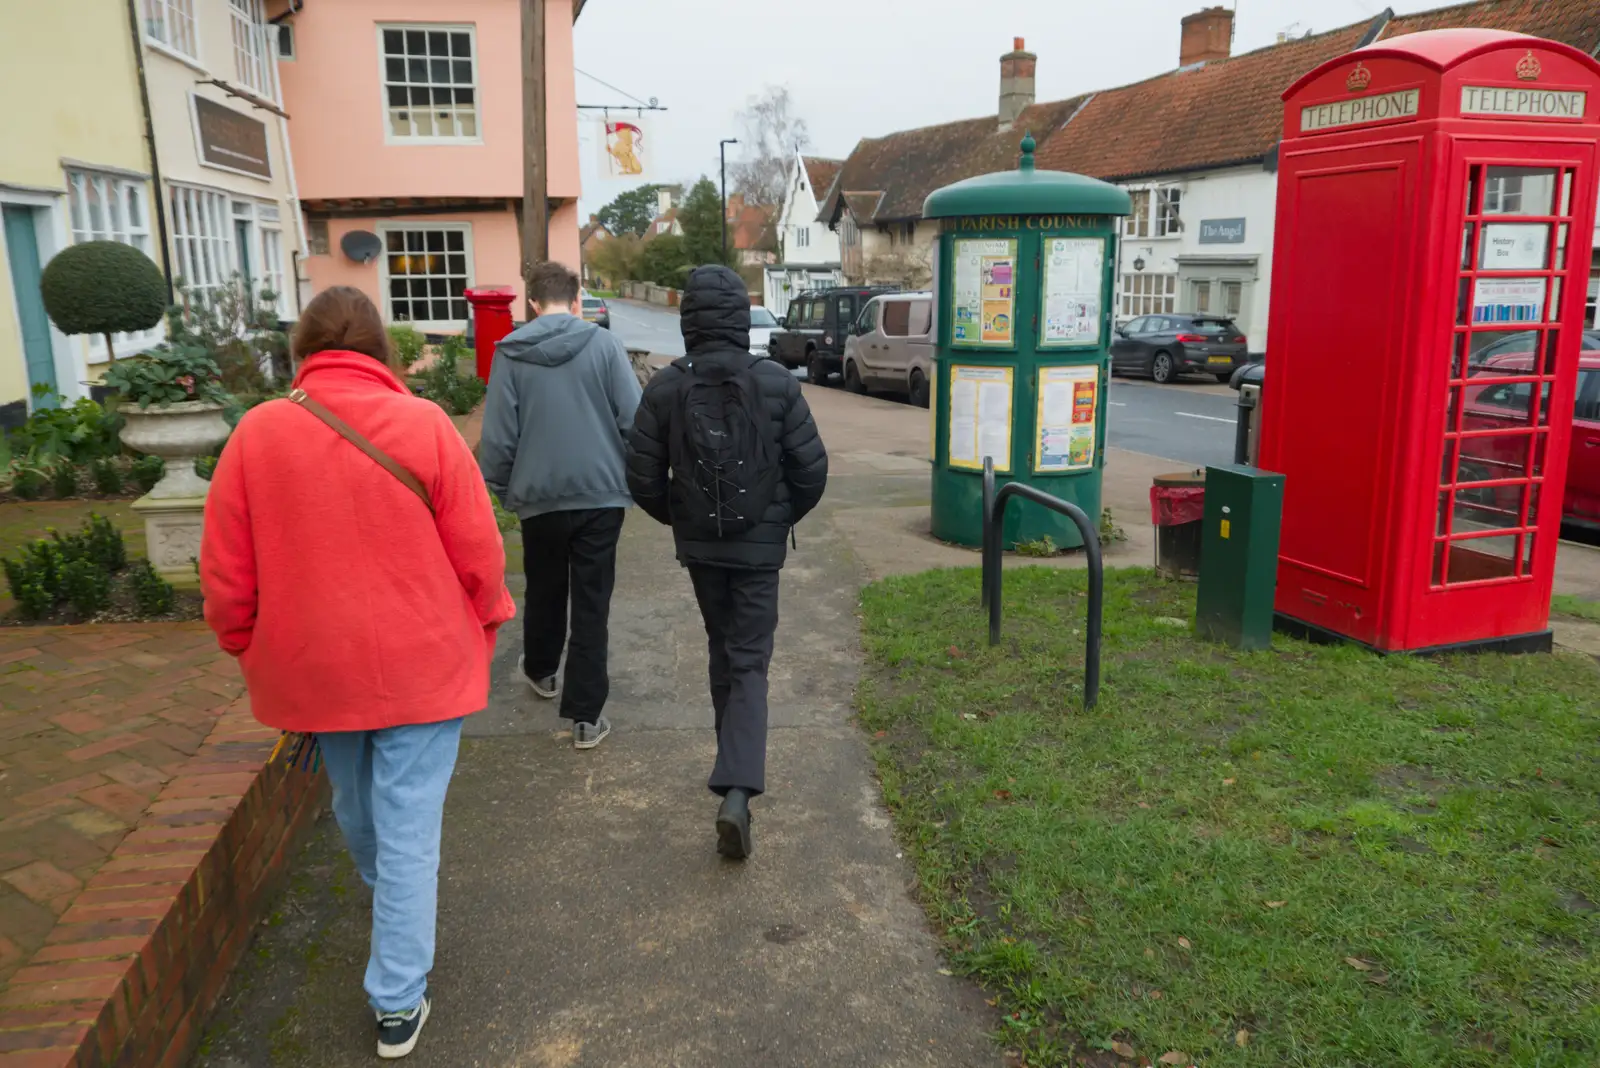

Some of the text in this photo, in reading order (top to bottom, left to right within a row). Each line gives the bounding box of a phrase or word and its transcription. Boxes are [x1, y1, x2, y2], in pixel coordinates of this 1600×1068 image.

[1307, 91, 1415, 128] TELEPHONE
[1465, 88, 1581, 115] TELEPHONE
[961, 215, 1019, 231] PARISH
[1203, 223, 1242, 240] The Angel
[1492, 238, 1515, 248] History
[1496, 249, 1509, 257] Box
